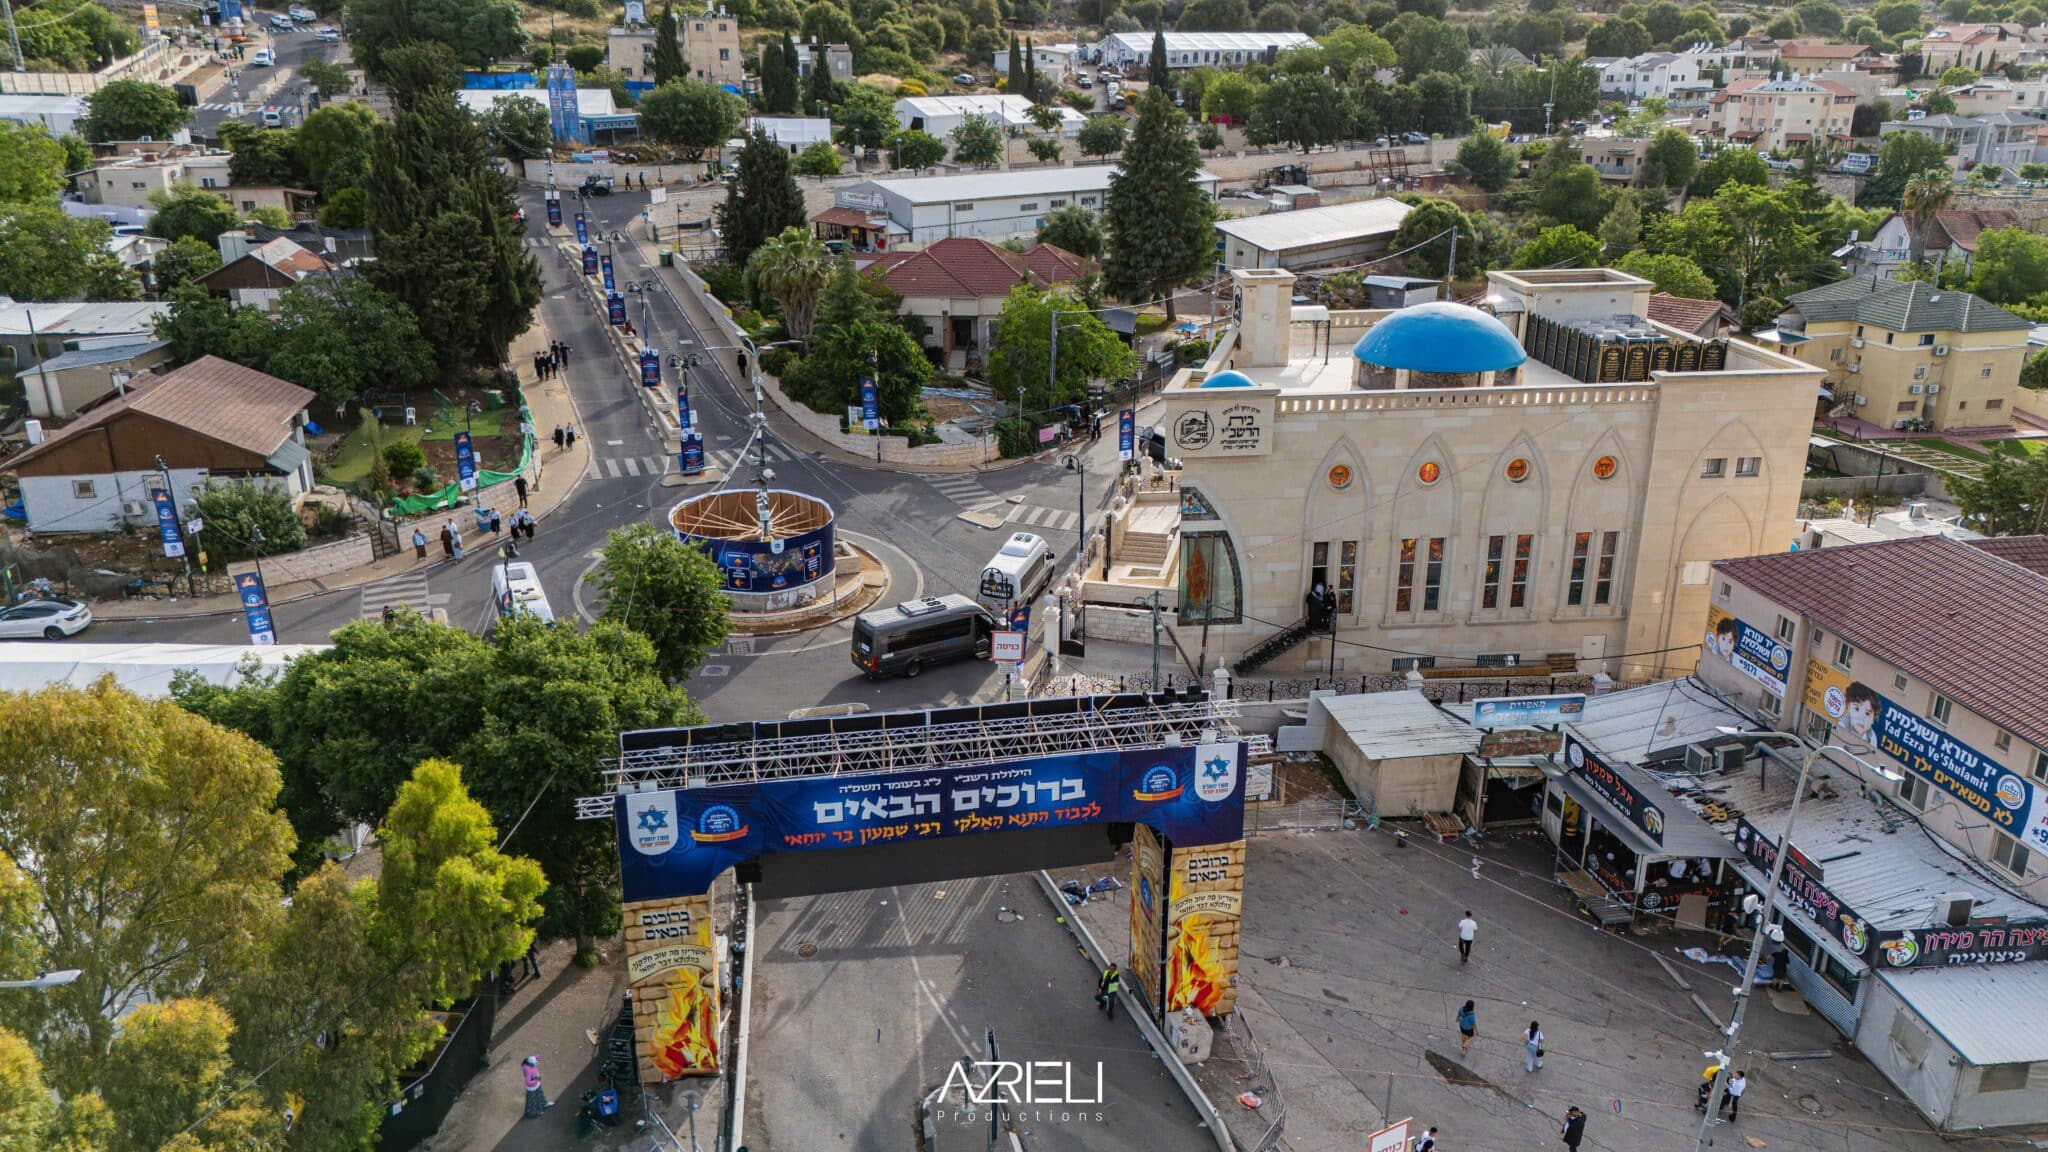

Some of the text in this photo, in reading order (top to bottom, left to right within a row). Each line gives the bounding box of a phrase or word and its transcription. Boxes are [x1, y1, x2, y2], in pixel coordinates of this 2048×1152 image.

[1229, 416, 1254, 426] בית
[996, 642, 1019, 651] כניסה
[1510, 701, 1546, 709] מאפיית
[1885, 706, 1997, 777] יד עזרא ושולמית
[1884, 720, 1989, 792] Yad Ezra Ve'Shulamit
[839, 768, 1032, 794] הילולת רשב"י ל"ג בעומר תשפ"ה
[1880, 735, 2013, 826] לא משאירים ילד רעב!
[813, 777, 1086, 824] ברוכים הבאים
[1189, 856, 1229, 869] ברוכים
[1189, 870, 1227, 883] הבאים
[1786, 863, 1805, 891] הר
[1765, 868, 1816, 920] פיצוציה
[1805, 880, 1839, 920] פיצה
[642, 911, 690, 926] ברוכים
[645, 926, 689, 940] הבאים
[1924, 931, 1974, 954] מירון
[1979, 930, 2004, 947] הר
[1948, 951, 2026, 964] פיצוצייה
